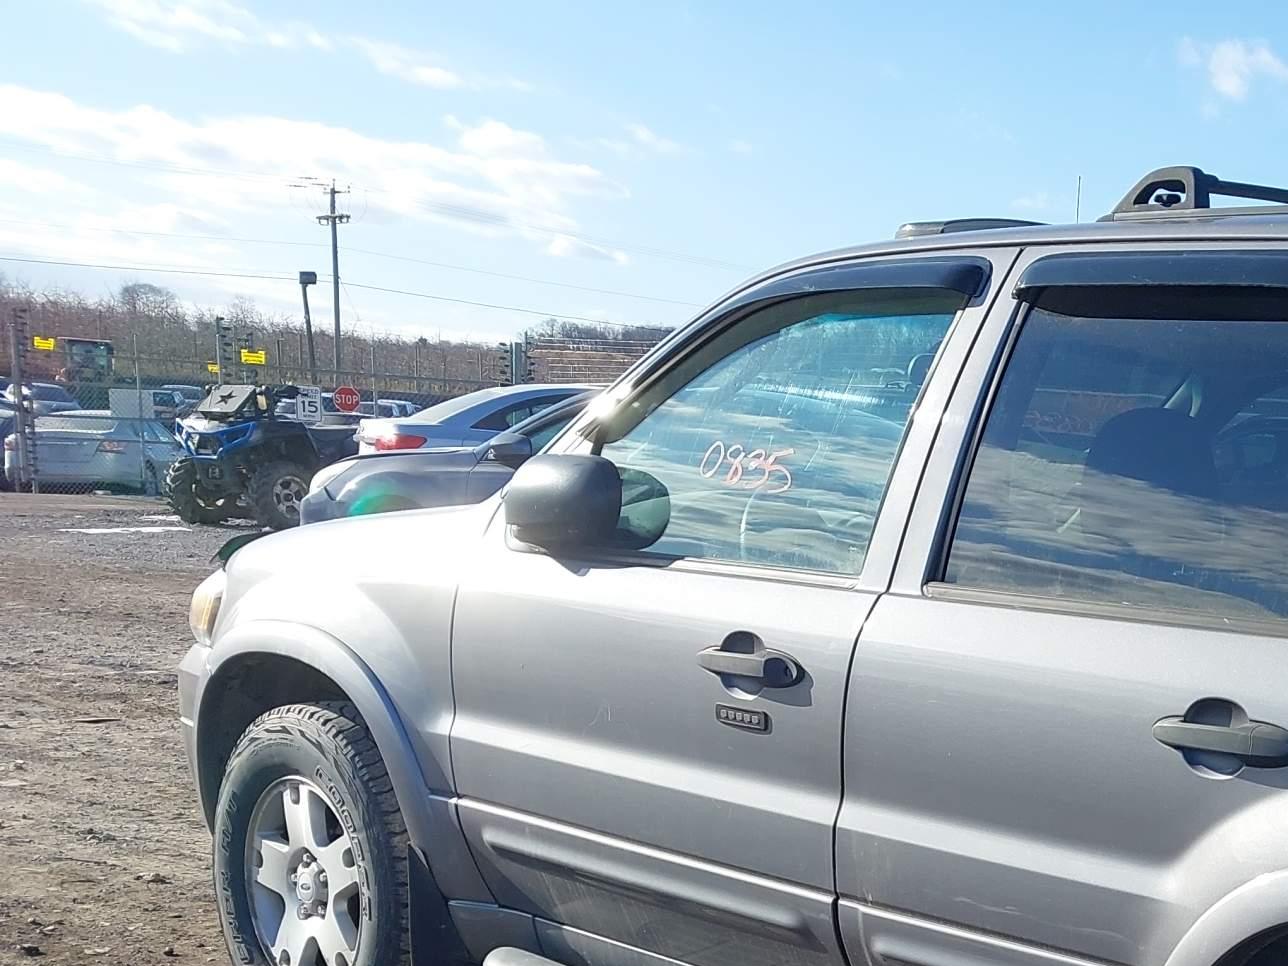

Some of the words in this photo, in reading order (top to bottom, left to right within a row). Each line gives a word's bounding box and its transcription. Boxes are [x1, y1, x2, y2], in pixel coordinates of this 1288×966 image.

[335, 394, 358, 404] STOP
[301, 400, 318, 413] 15
[699, 439, 796, 494] 0835
